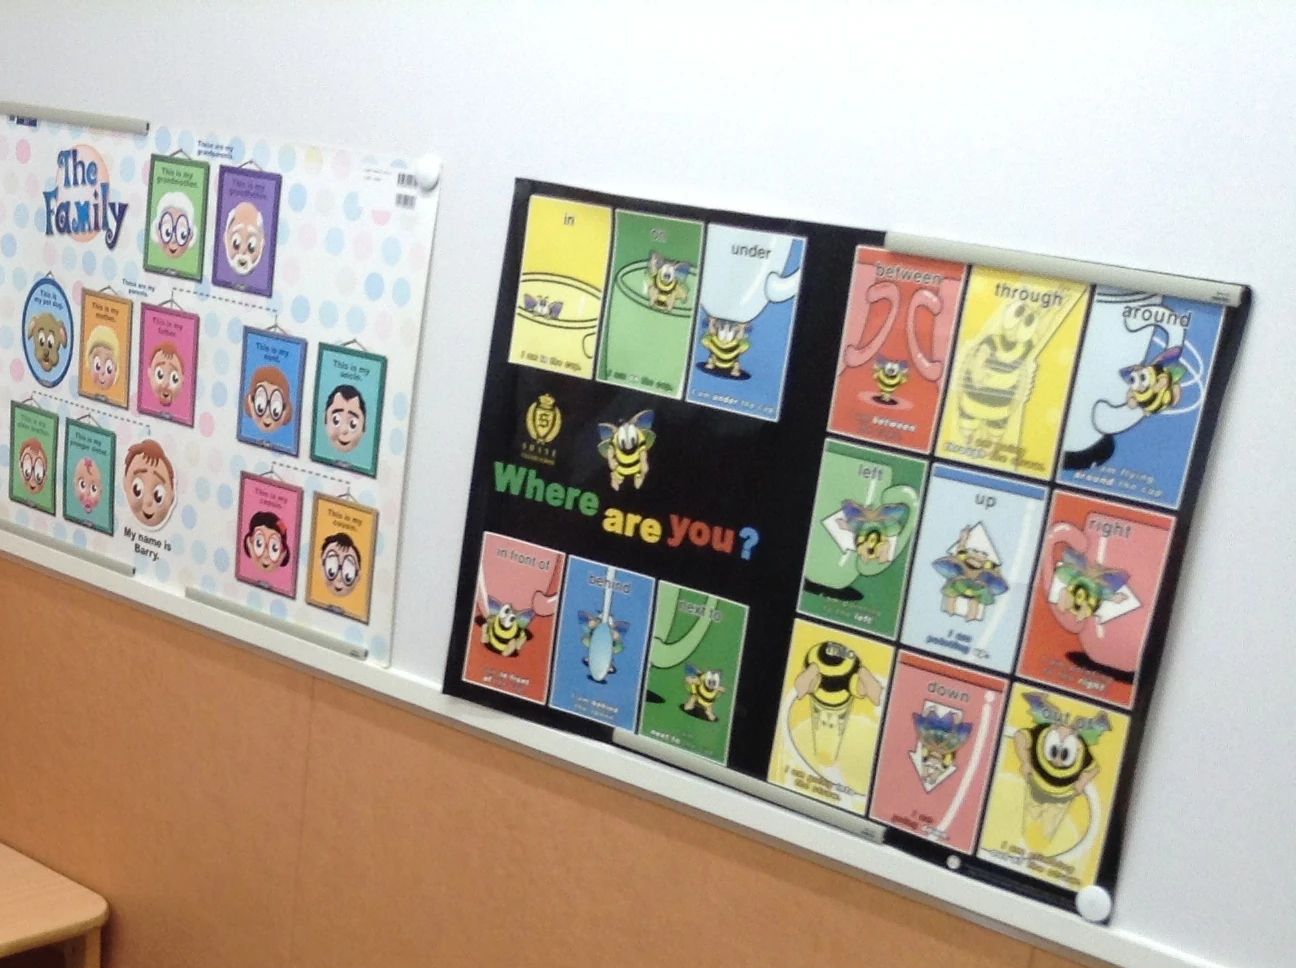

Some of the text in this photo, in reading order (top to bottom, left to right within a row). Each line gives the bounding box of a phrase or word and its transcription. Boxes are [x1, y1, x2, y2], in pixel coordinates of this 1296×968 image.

[57, 148, 99, 187] The
[42, 182, 129, 250] Family
[563, 211, 575, 226] in
[731, 243, 772, 260] under
[876, 263, 943, 285] between
[994, 281, 1064, 307] through
[92, 302, 105, 311] This
[110, 308, 119, 316] my
[1122, 303, 1193, 327] around
[256, 342, 270, 351] This
[278, 349, 289, 358] my
[333, 360, 348, 370] This
[359, 367, 370, 376] my
[871, 416, 917, 432] between
[75, 432, 87, 441] This
[857, 463, 883, 482] left
[493, 460, 600, 517] Where
[602, 507, 662, 544] are
[975, 491, 997, 508] up
[328, 509, 342, 519] This
[352, 517, 363, 526] my
[124, 526, 172, 551] My name is
[1089, 517, 1132, 540] right
[134, 543, 160, 561] Barry.
[496, 547, 551, 571] in front of
[587, 573, 631, 594] behind
[679, 600, 722, 622] next to
[927, 680, 970, 703] down
[1041, 705, 1071, 725] out
